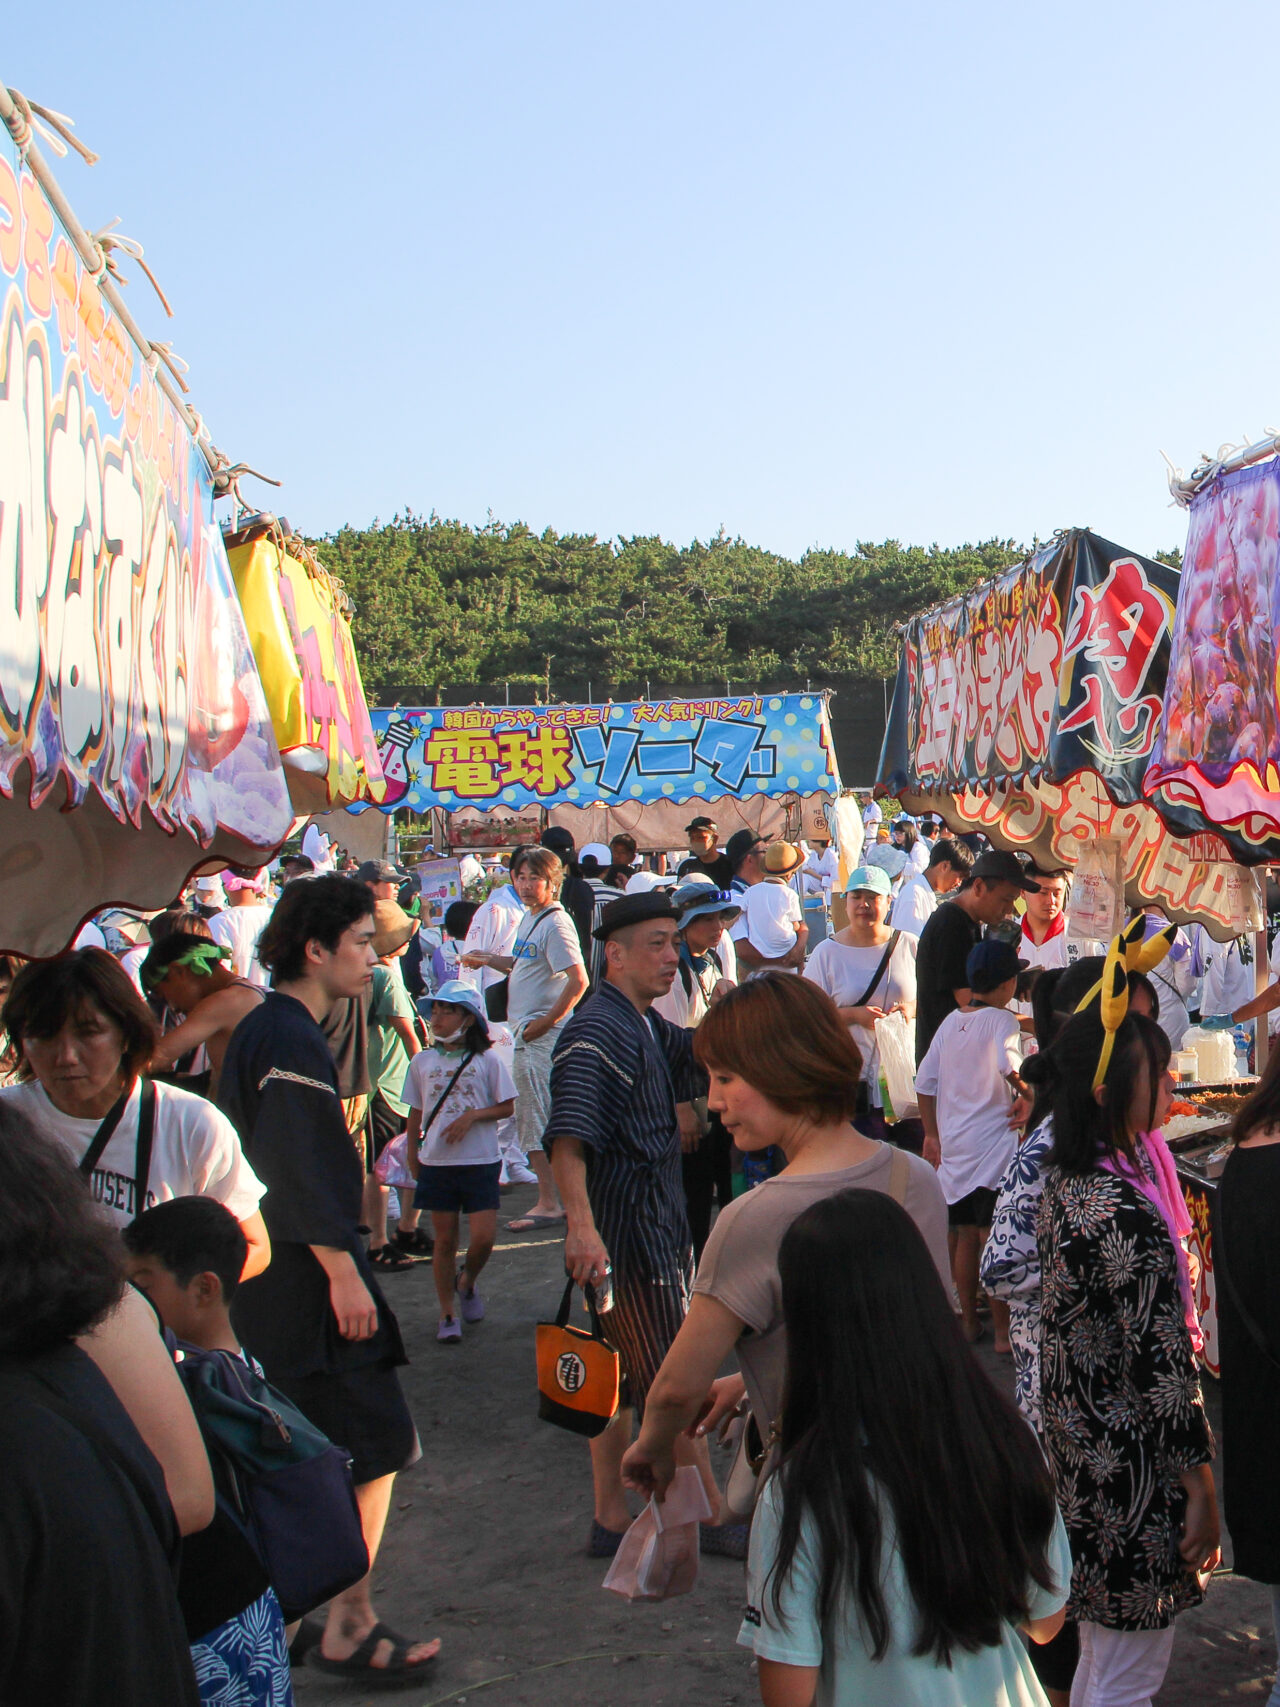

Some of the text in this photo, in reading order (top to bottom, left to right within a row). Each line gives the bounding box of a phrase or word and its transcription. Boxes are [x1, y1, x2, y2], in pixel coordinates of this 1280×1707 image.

[443, 697, 764, 730] 韓国からやってきた! 大人気ドリンク!
[424, 717, 777, 798] 電球ソーダ
